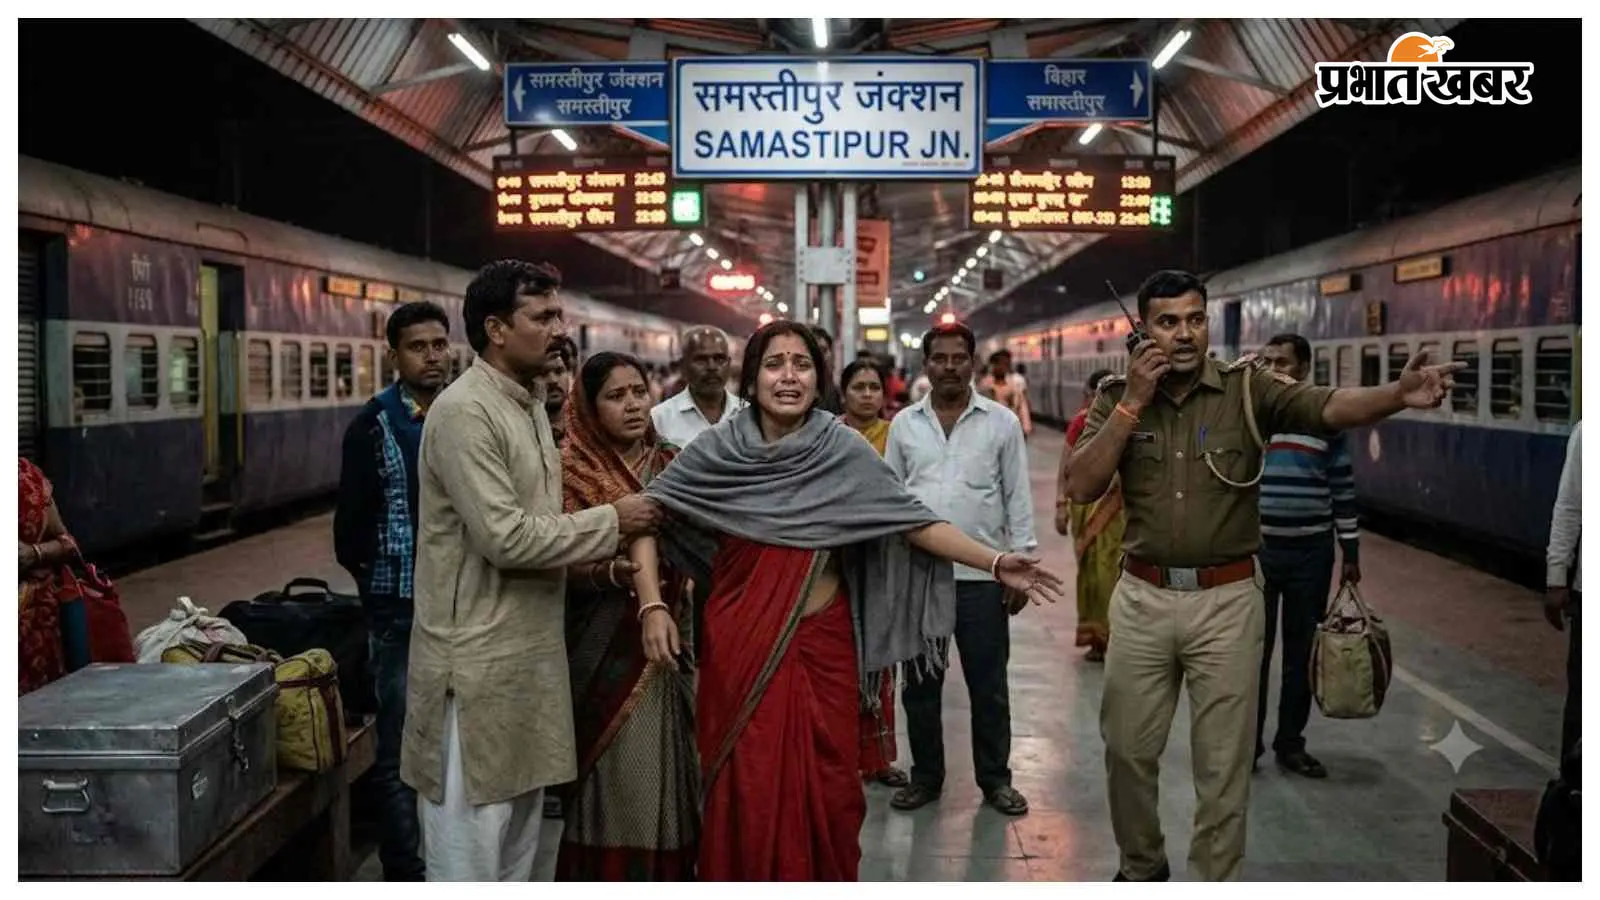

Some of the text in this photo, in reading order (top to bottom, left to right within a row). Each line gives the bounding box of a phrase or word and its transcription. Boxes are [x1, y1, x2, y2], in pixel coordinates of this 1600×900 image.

[1044, 64, 1088, 88] बिहार
[555, 93, 633, 120] समस्तीपुर
[692, 68, 965, 125] समस्तीपुर जंक्शन
[694, 130, 970, 159] SAMASTIPUR JN.
